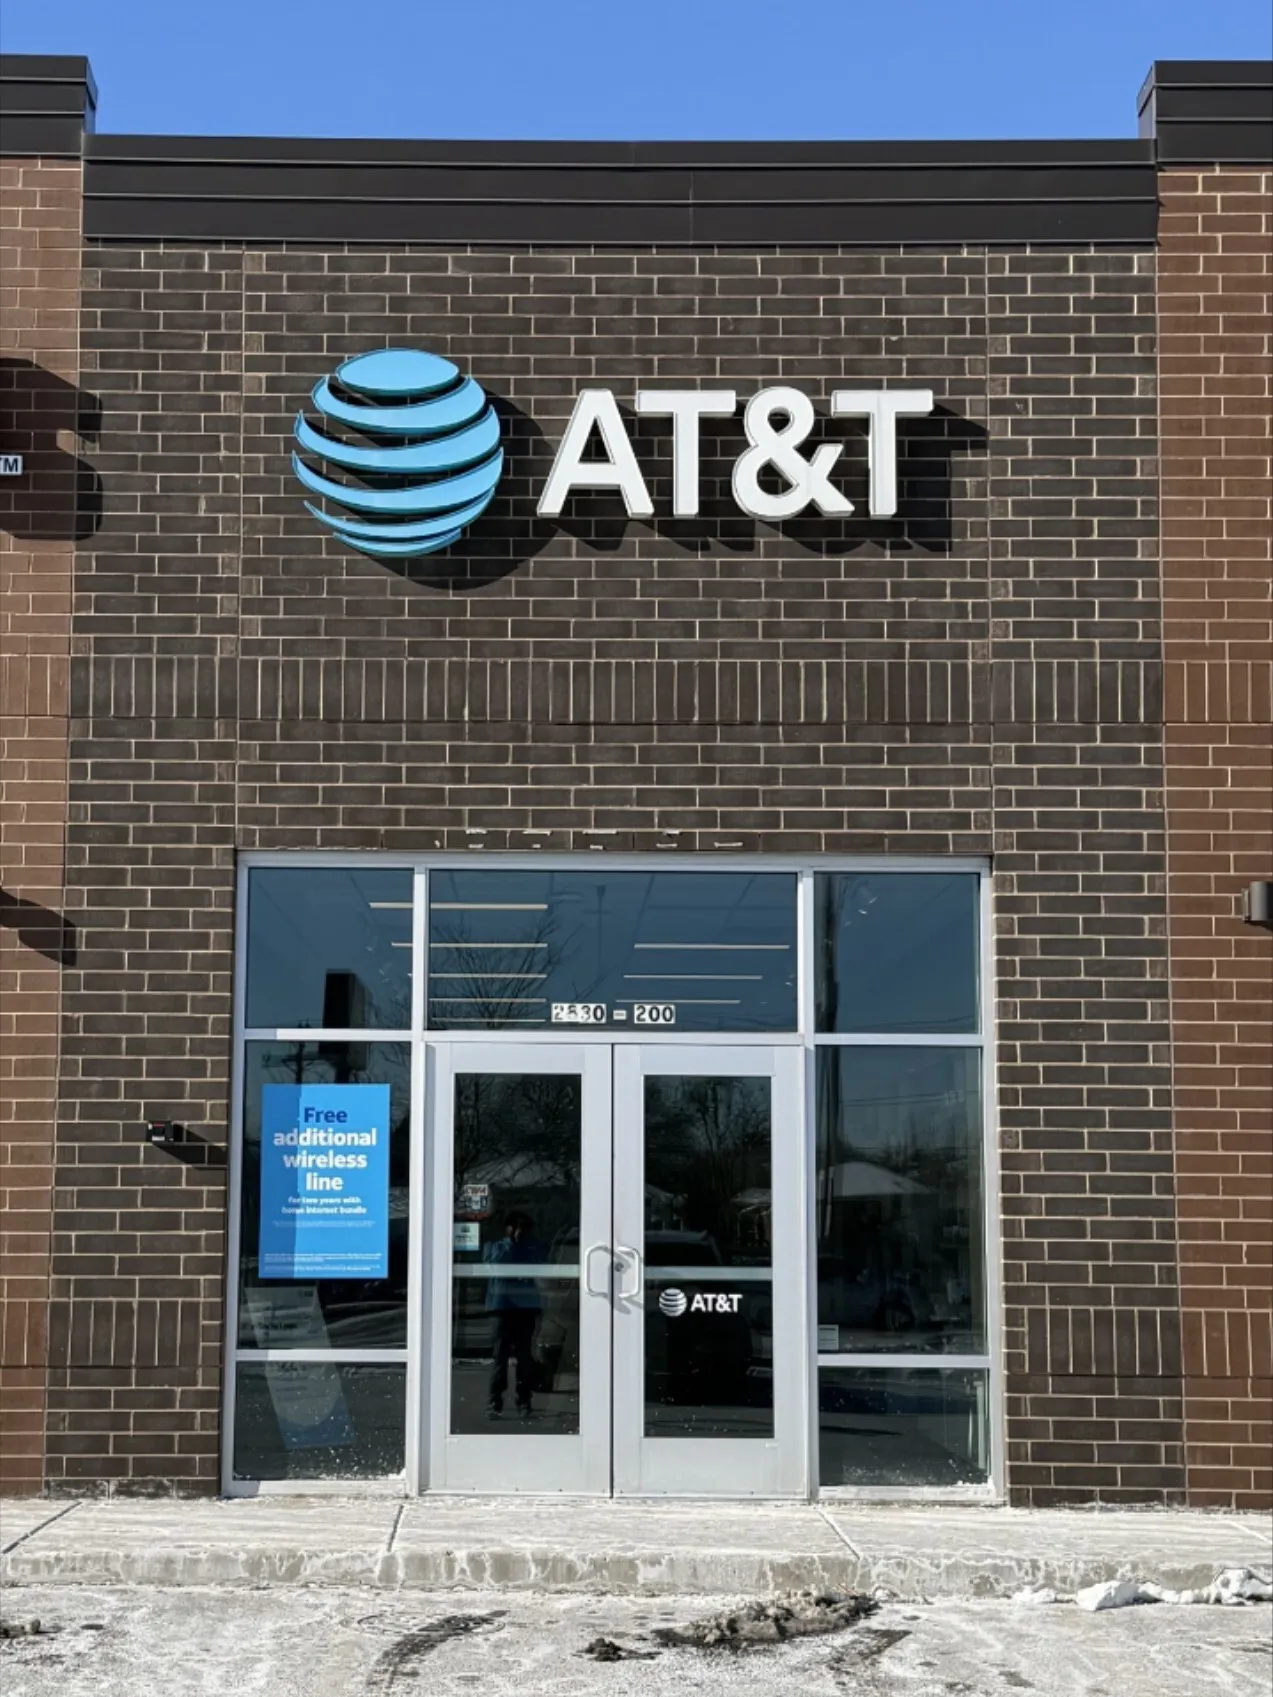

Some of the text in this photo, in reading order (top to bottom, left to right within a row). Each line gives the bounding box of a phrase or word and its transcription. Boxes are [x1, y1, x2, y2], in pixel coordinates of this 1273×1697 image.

[536, 386, 934, 521] AT&T
[0, 457, 19, 473] M
[635, 1004, 675, 1023] 200
[304, 1107, 348, 1124] Free
[273, 1128, 377, 1146] additional
[283, 1150, 368, 1168] wireless
[305, 1172, 344, 1191] line
[690, 1293, 743, 1313] AT&T
